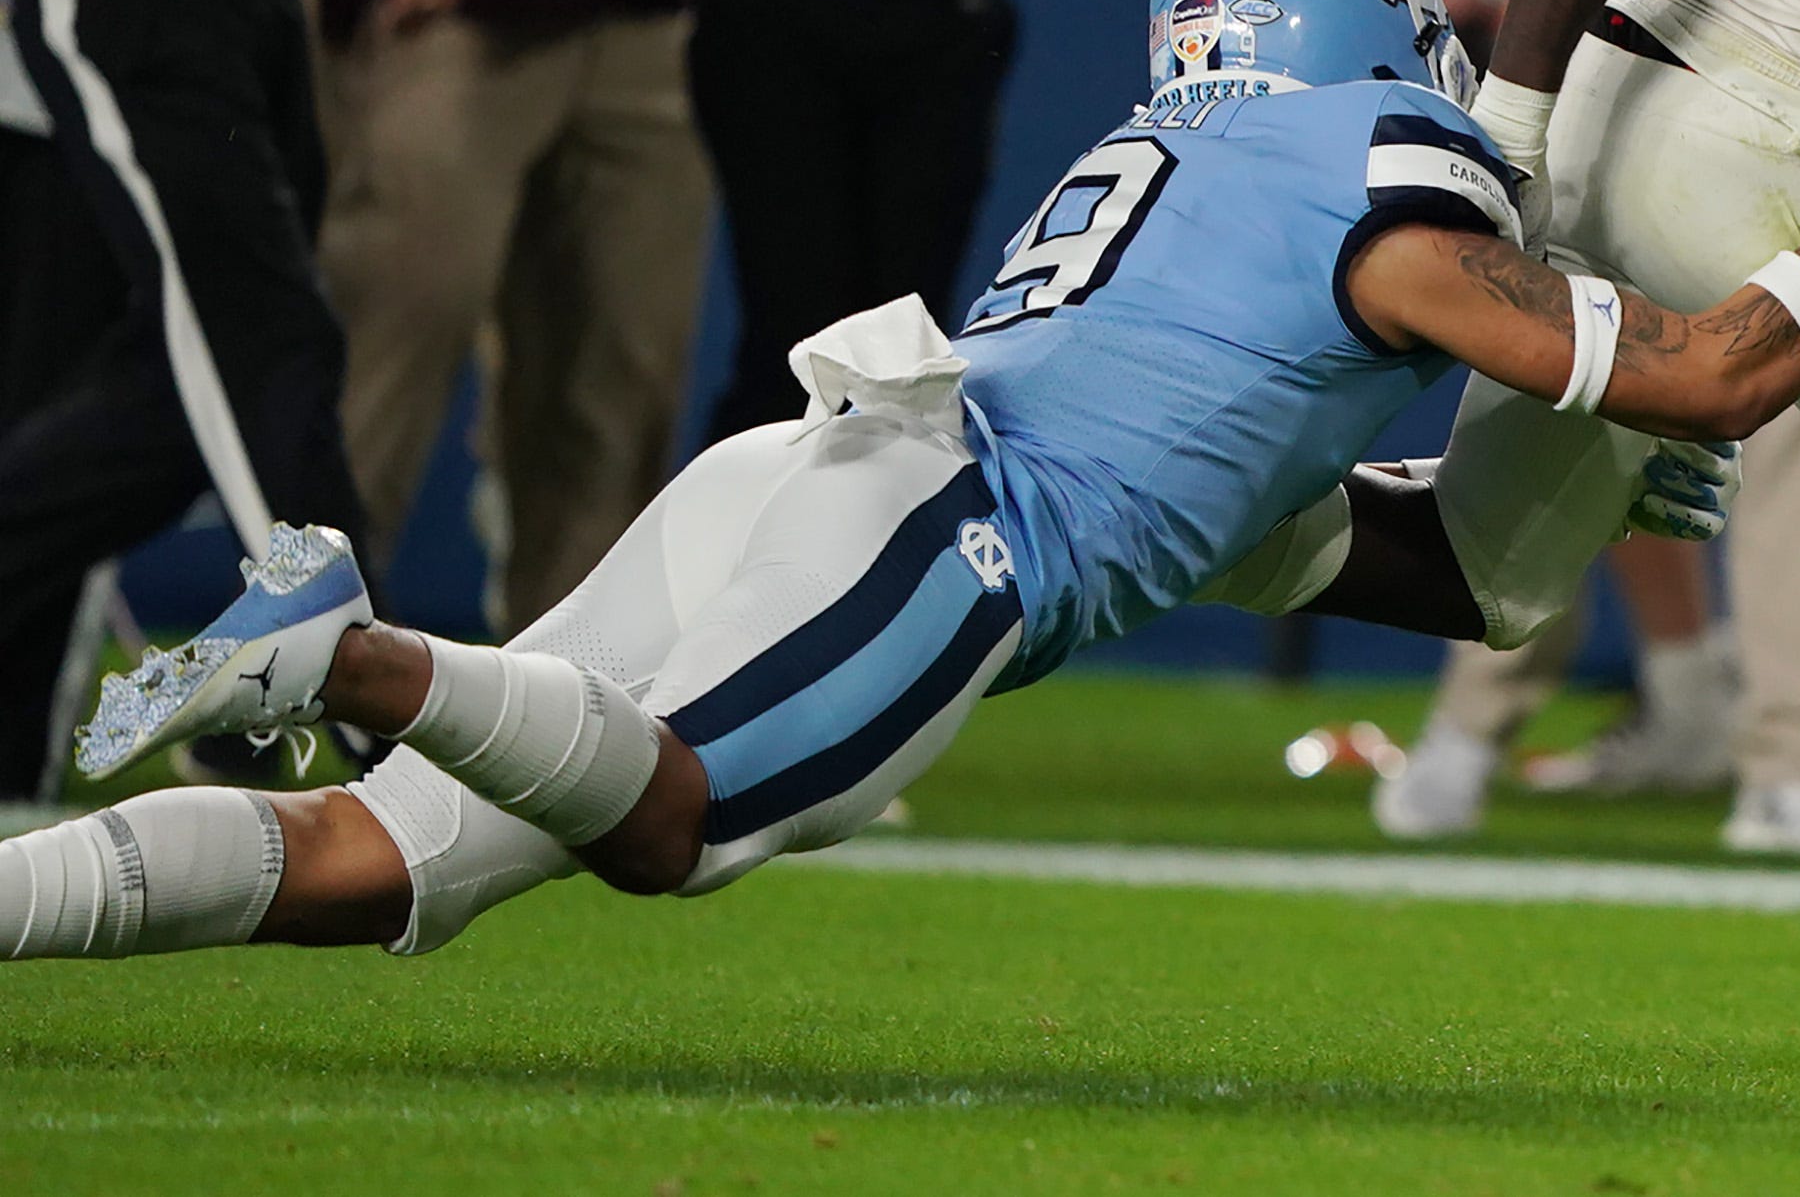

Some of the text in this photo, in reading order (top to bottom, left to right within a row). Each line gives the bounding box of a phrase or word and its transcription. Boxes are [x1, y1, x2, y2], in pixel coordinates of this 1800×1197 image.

[1237, 24, 1256, 67] 9
[1184, 79, 1271, 104] HEELS
[950, 135, 1181, 341] 9
